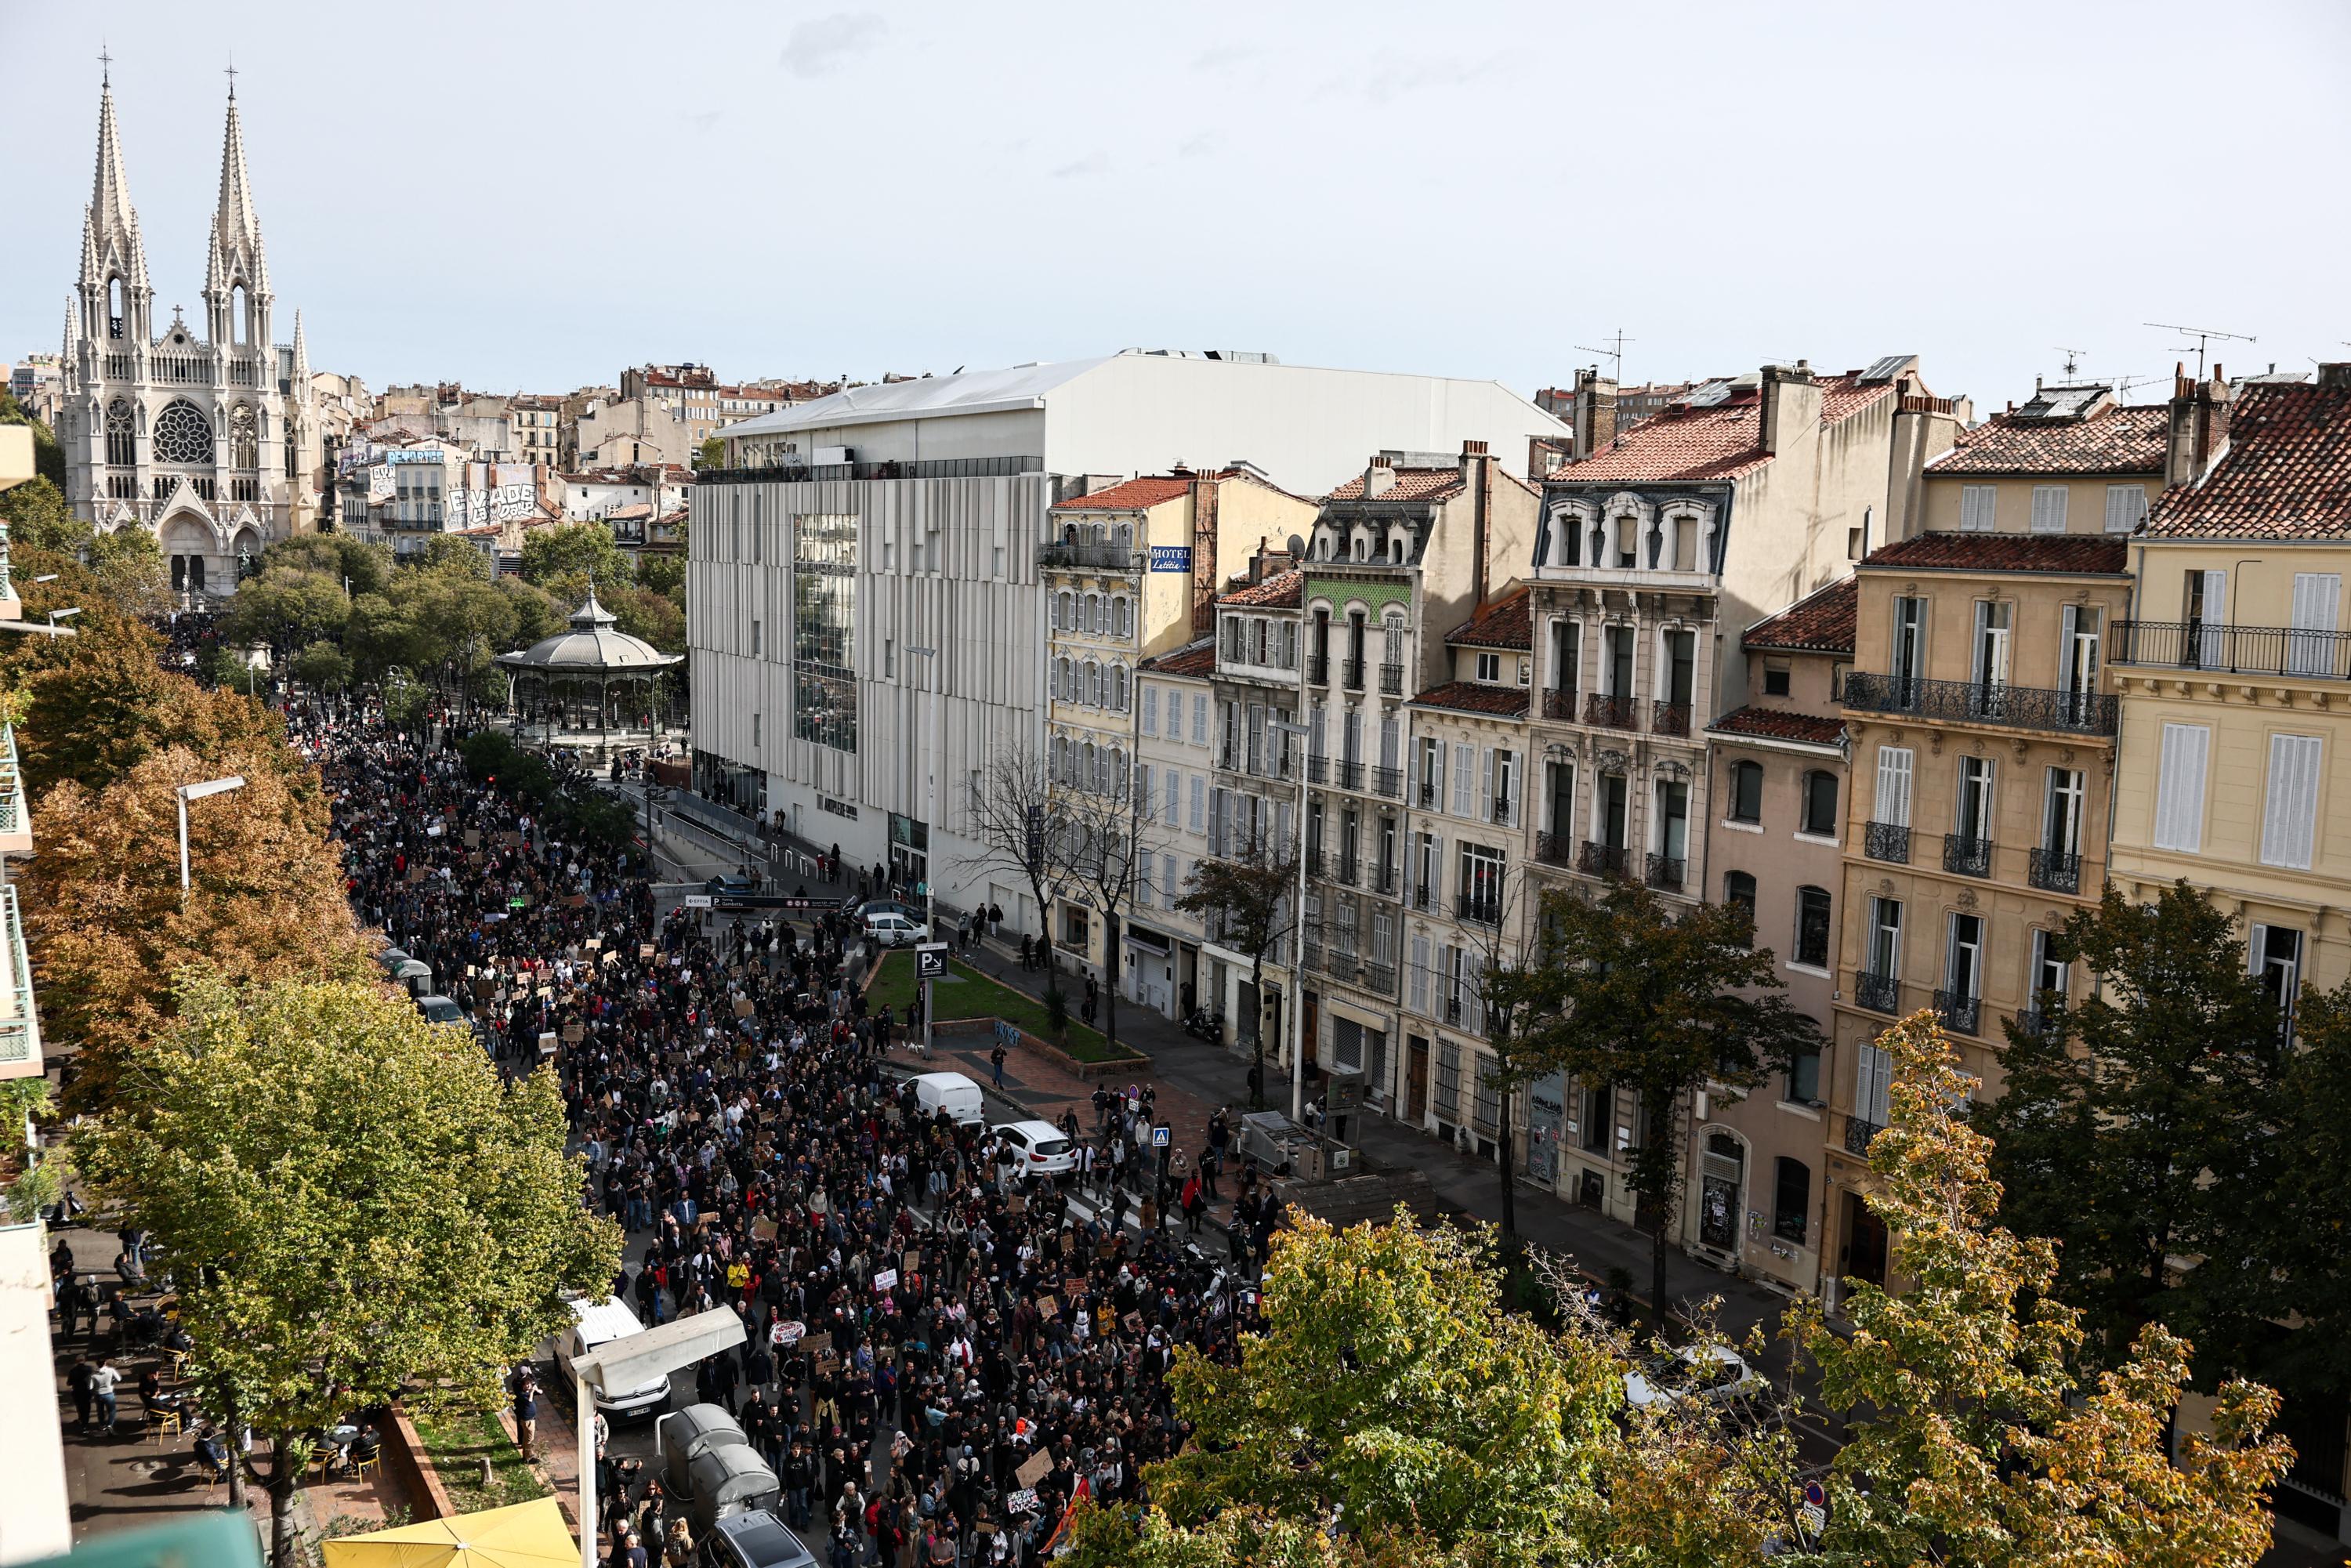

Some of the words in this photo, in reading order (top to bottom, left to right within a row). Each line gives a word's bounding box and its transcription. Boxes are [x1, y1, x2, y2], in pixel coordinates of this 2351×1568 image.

[1154, 549, 1190, 559] HOTEL
[1152, 559, 1180, 570] Lutétia
[922, 952, 933, 969] P
